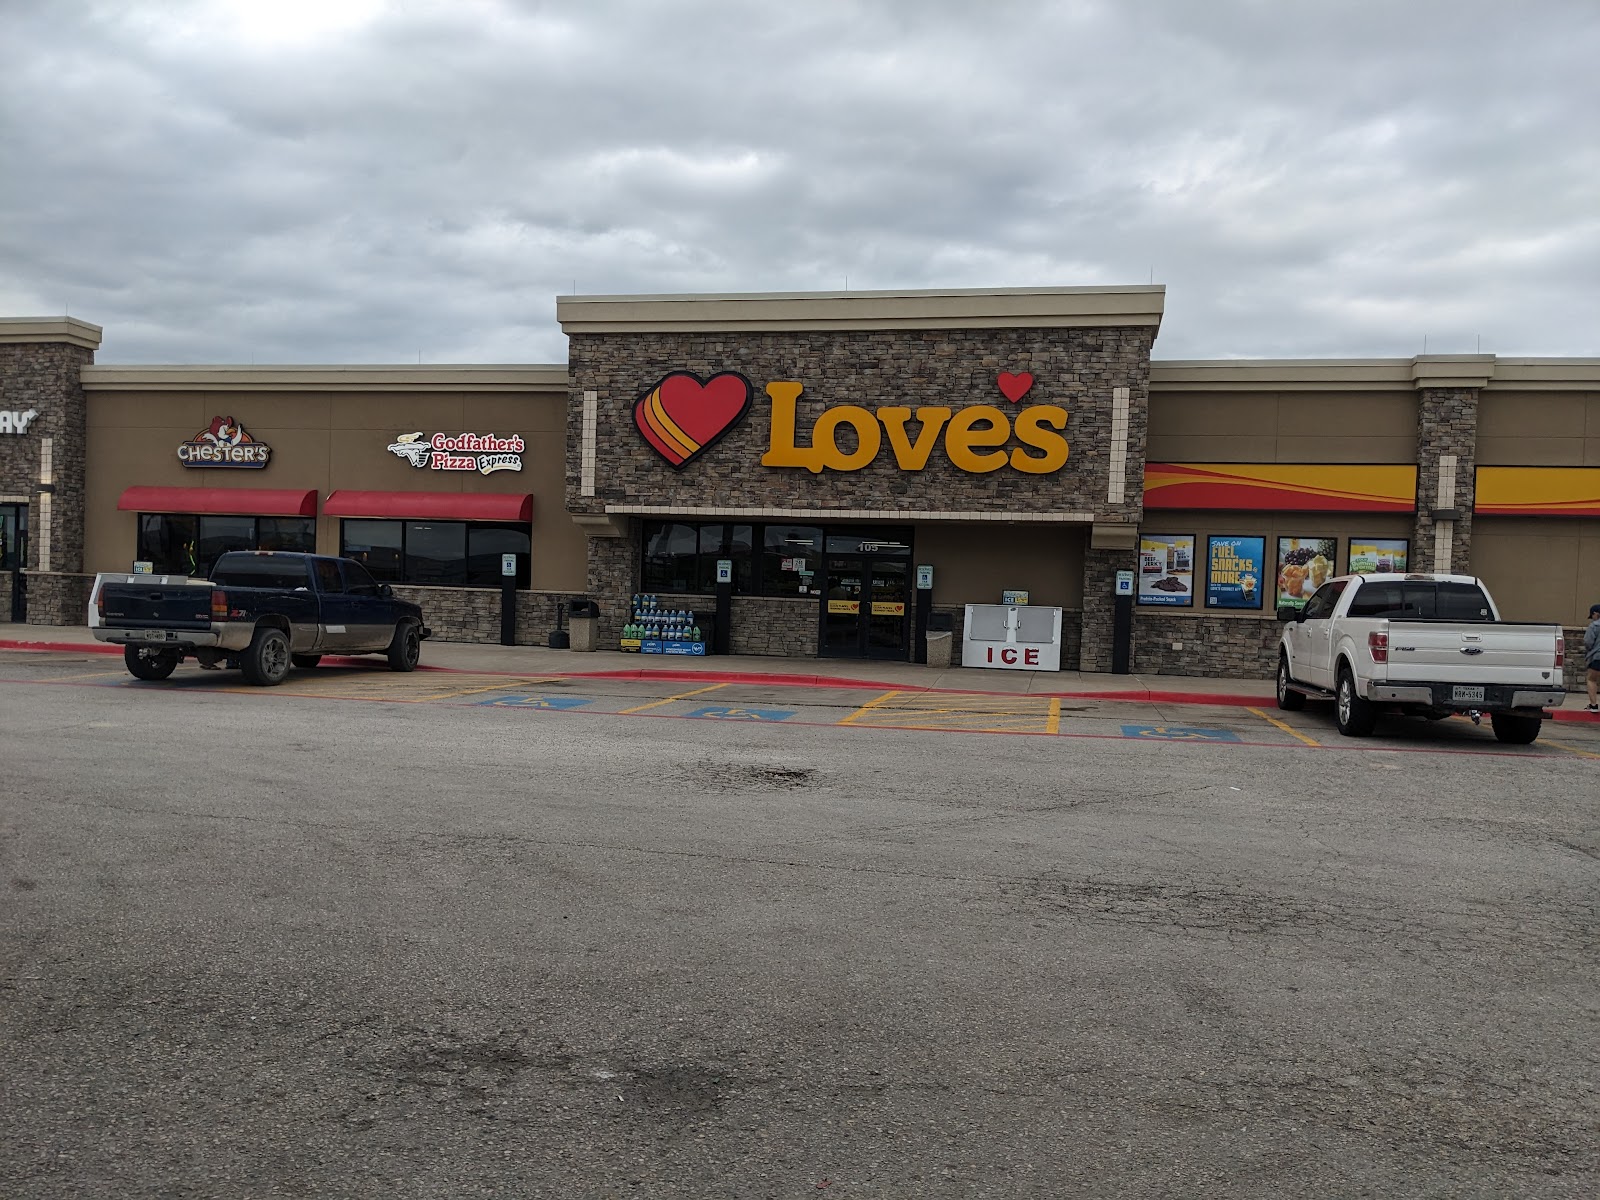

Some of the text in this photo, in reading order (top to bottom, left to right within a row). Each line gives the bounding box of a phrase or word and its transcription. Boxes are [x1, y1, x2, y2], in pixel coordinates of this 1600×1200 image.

[432, 433, 524, 452] Godfather's
[432, 452, 518, 470] Pizza Express
[987, 646, 1040, 666] ICE
